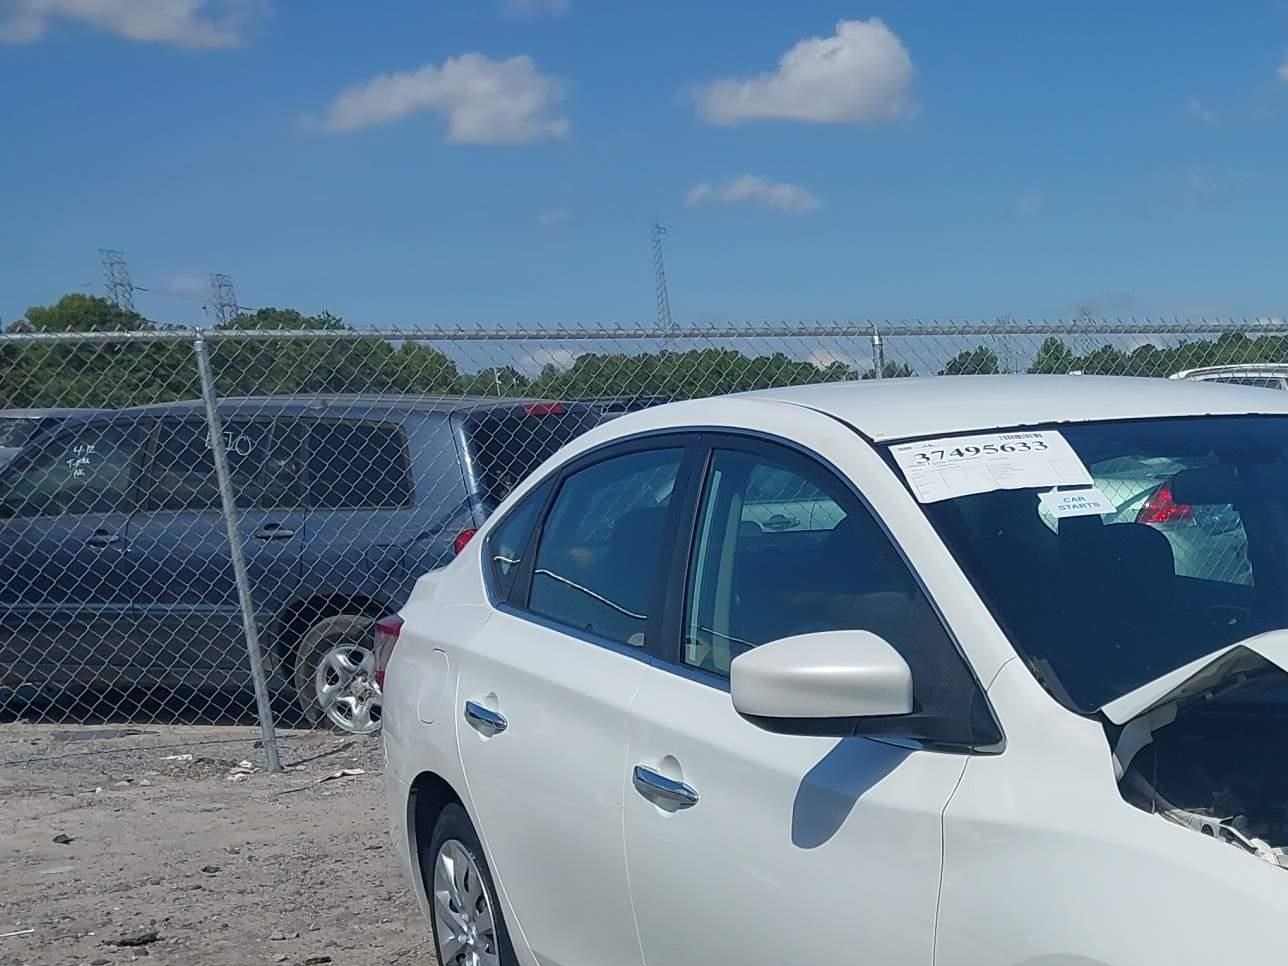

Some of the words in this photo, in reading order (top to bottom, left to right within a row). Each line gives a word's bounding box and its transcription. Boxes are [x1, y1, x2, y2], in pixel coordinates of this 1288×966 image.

[914, 440, 1049, 465] 37495633
[1063, 496, 1087, 504] CAR
[1057, 502, 1101, 511] STARTS
